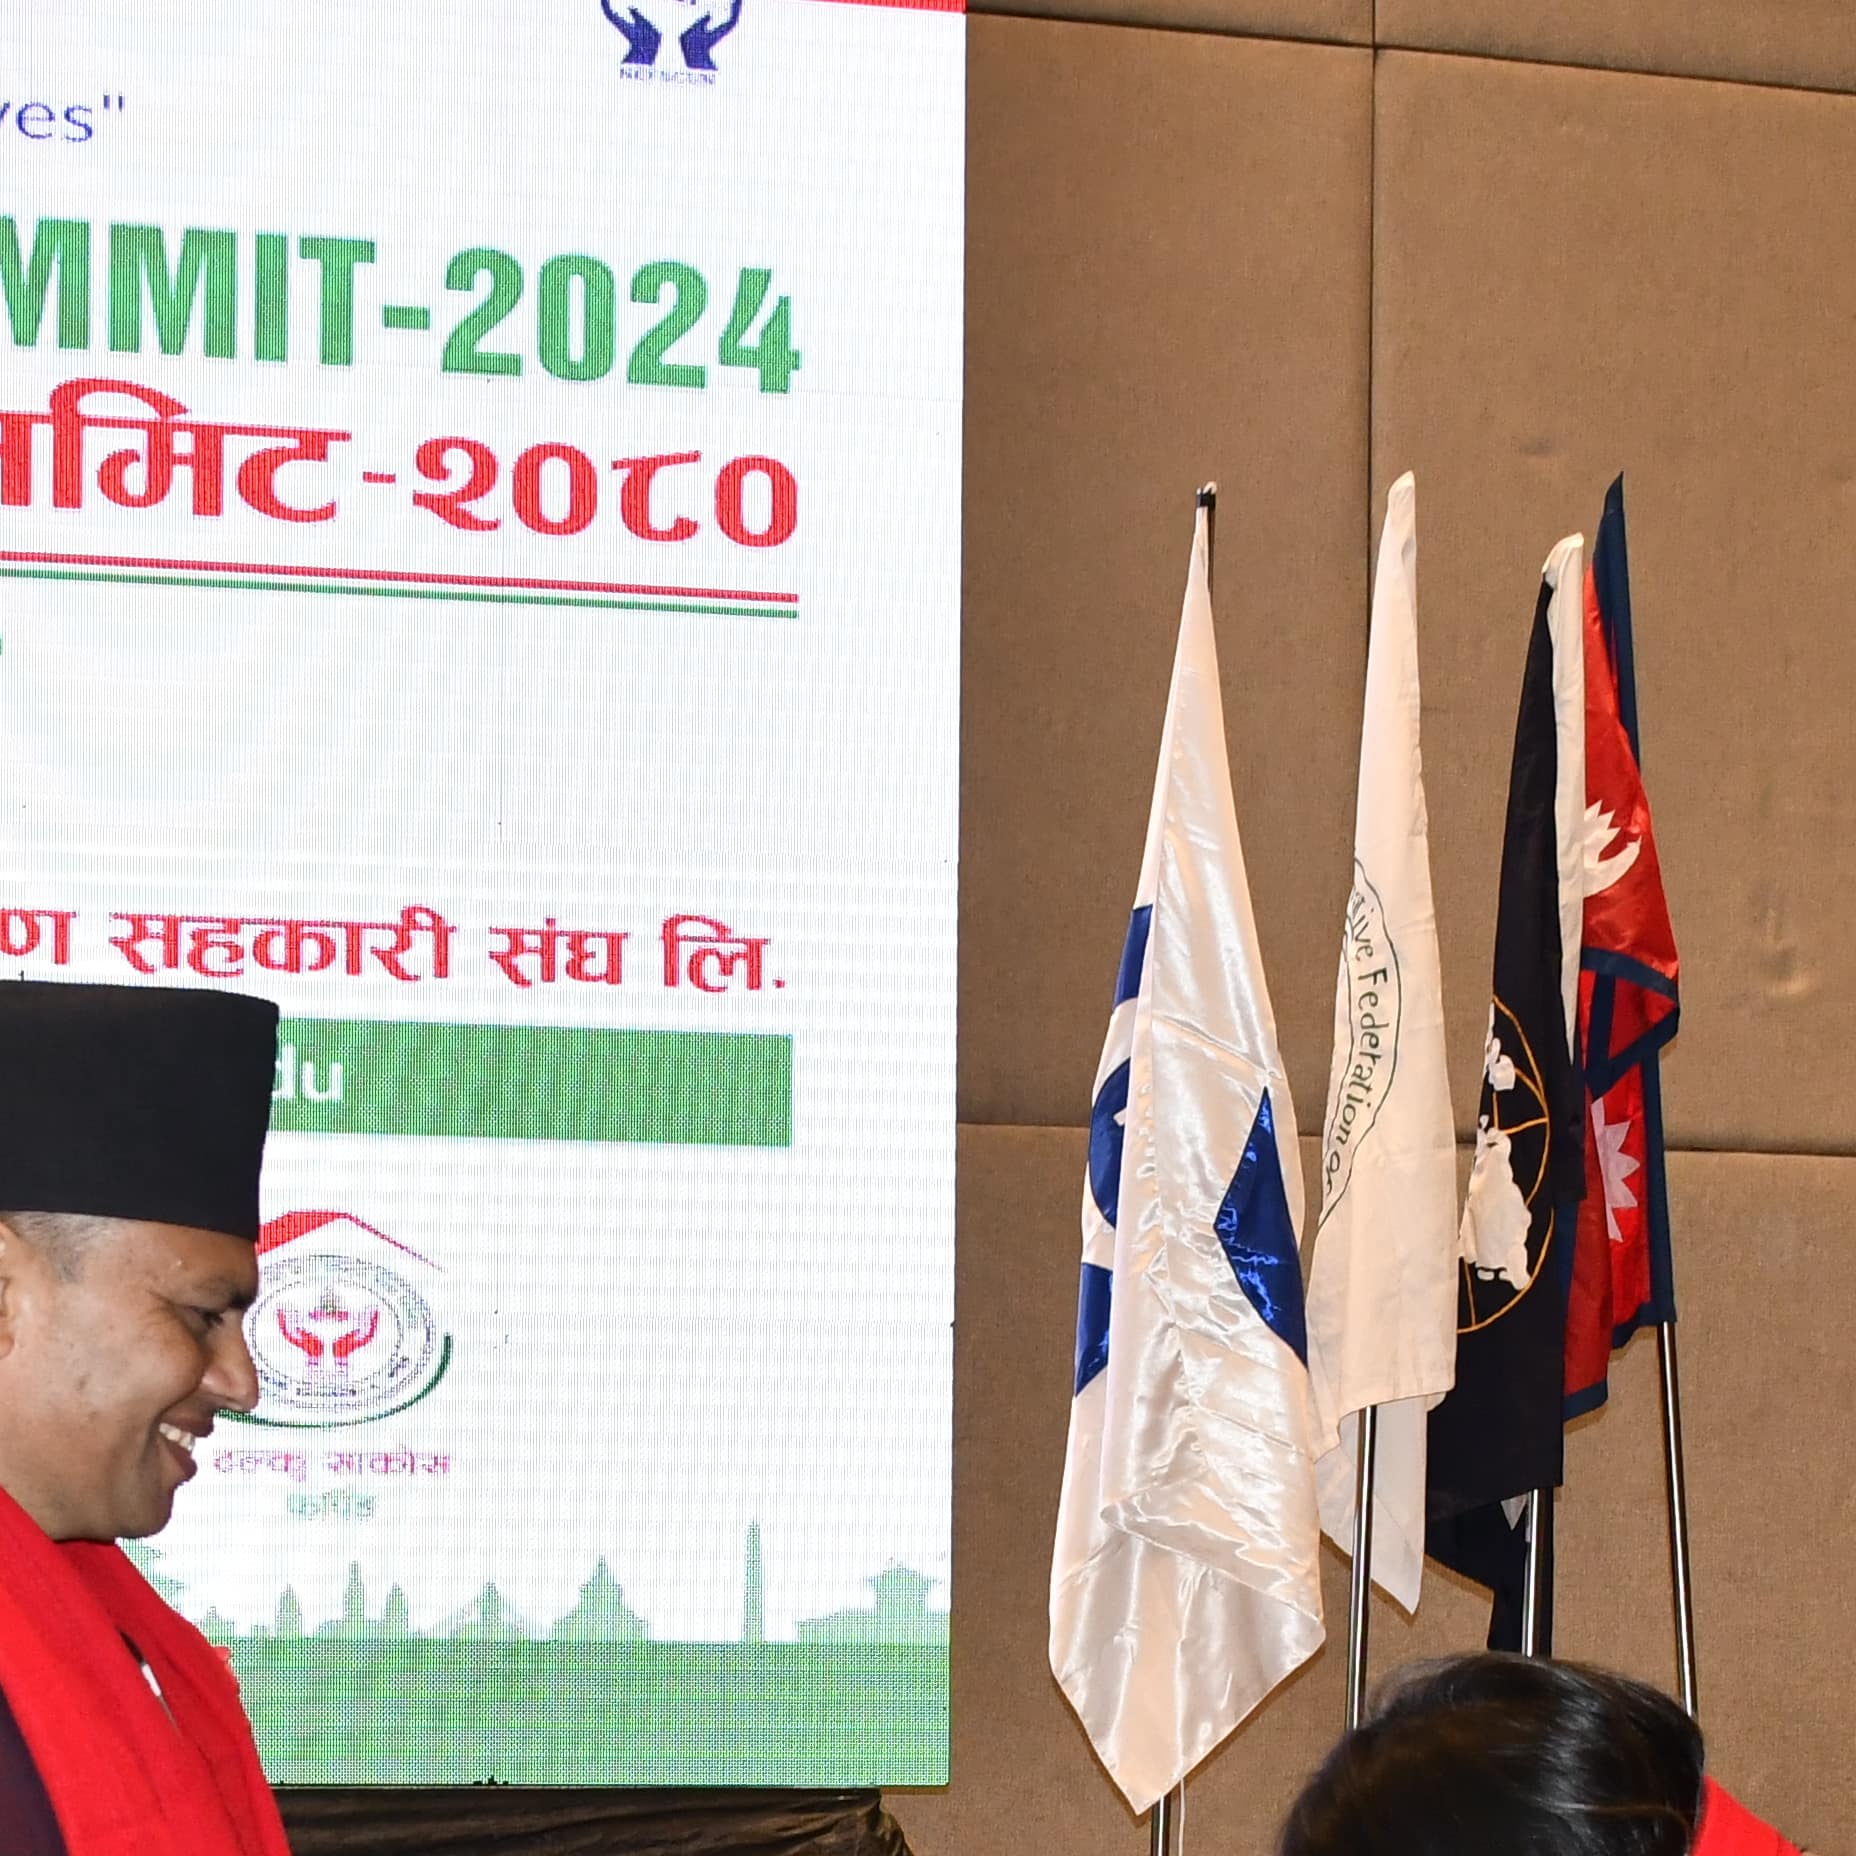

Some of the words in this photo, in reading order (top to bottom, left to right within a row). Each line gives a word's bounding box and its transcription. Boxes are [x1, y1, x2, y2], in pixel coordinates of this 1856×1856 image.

[108, 905, 458, 983] सहकारी
[488, 916, 631, 987] संघ
[660, 913, 785, 993] लि.
[1337, 966, 1389, 1146] Federation
